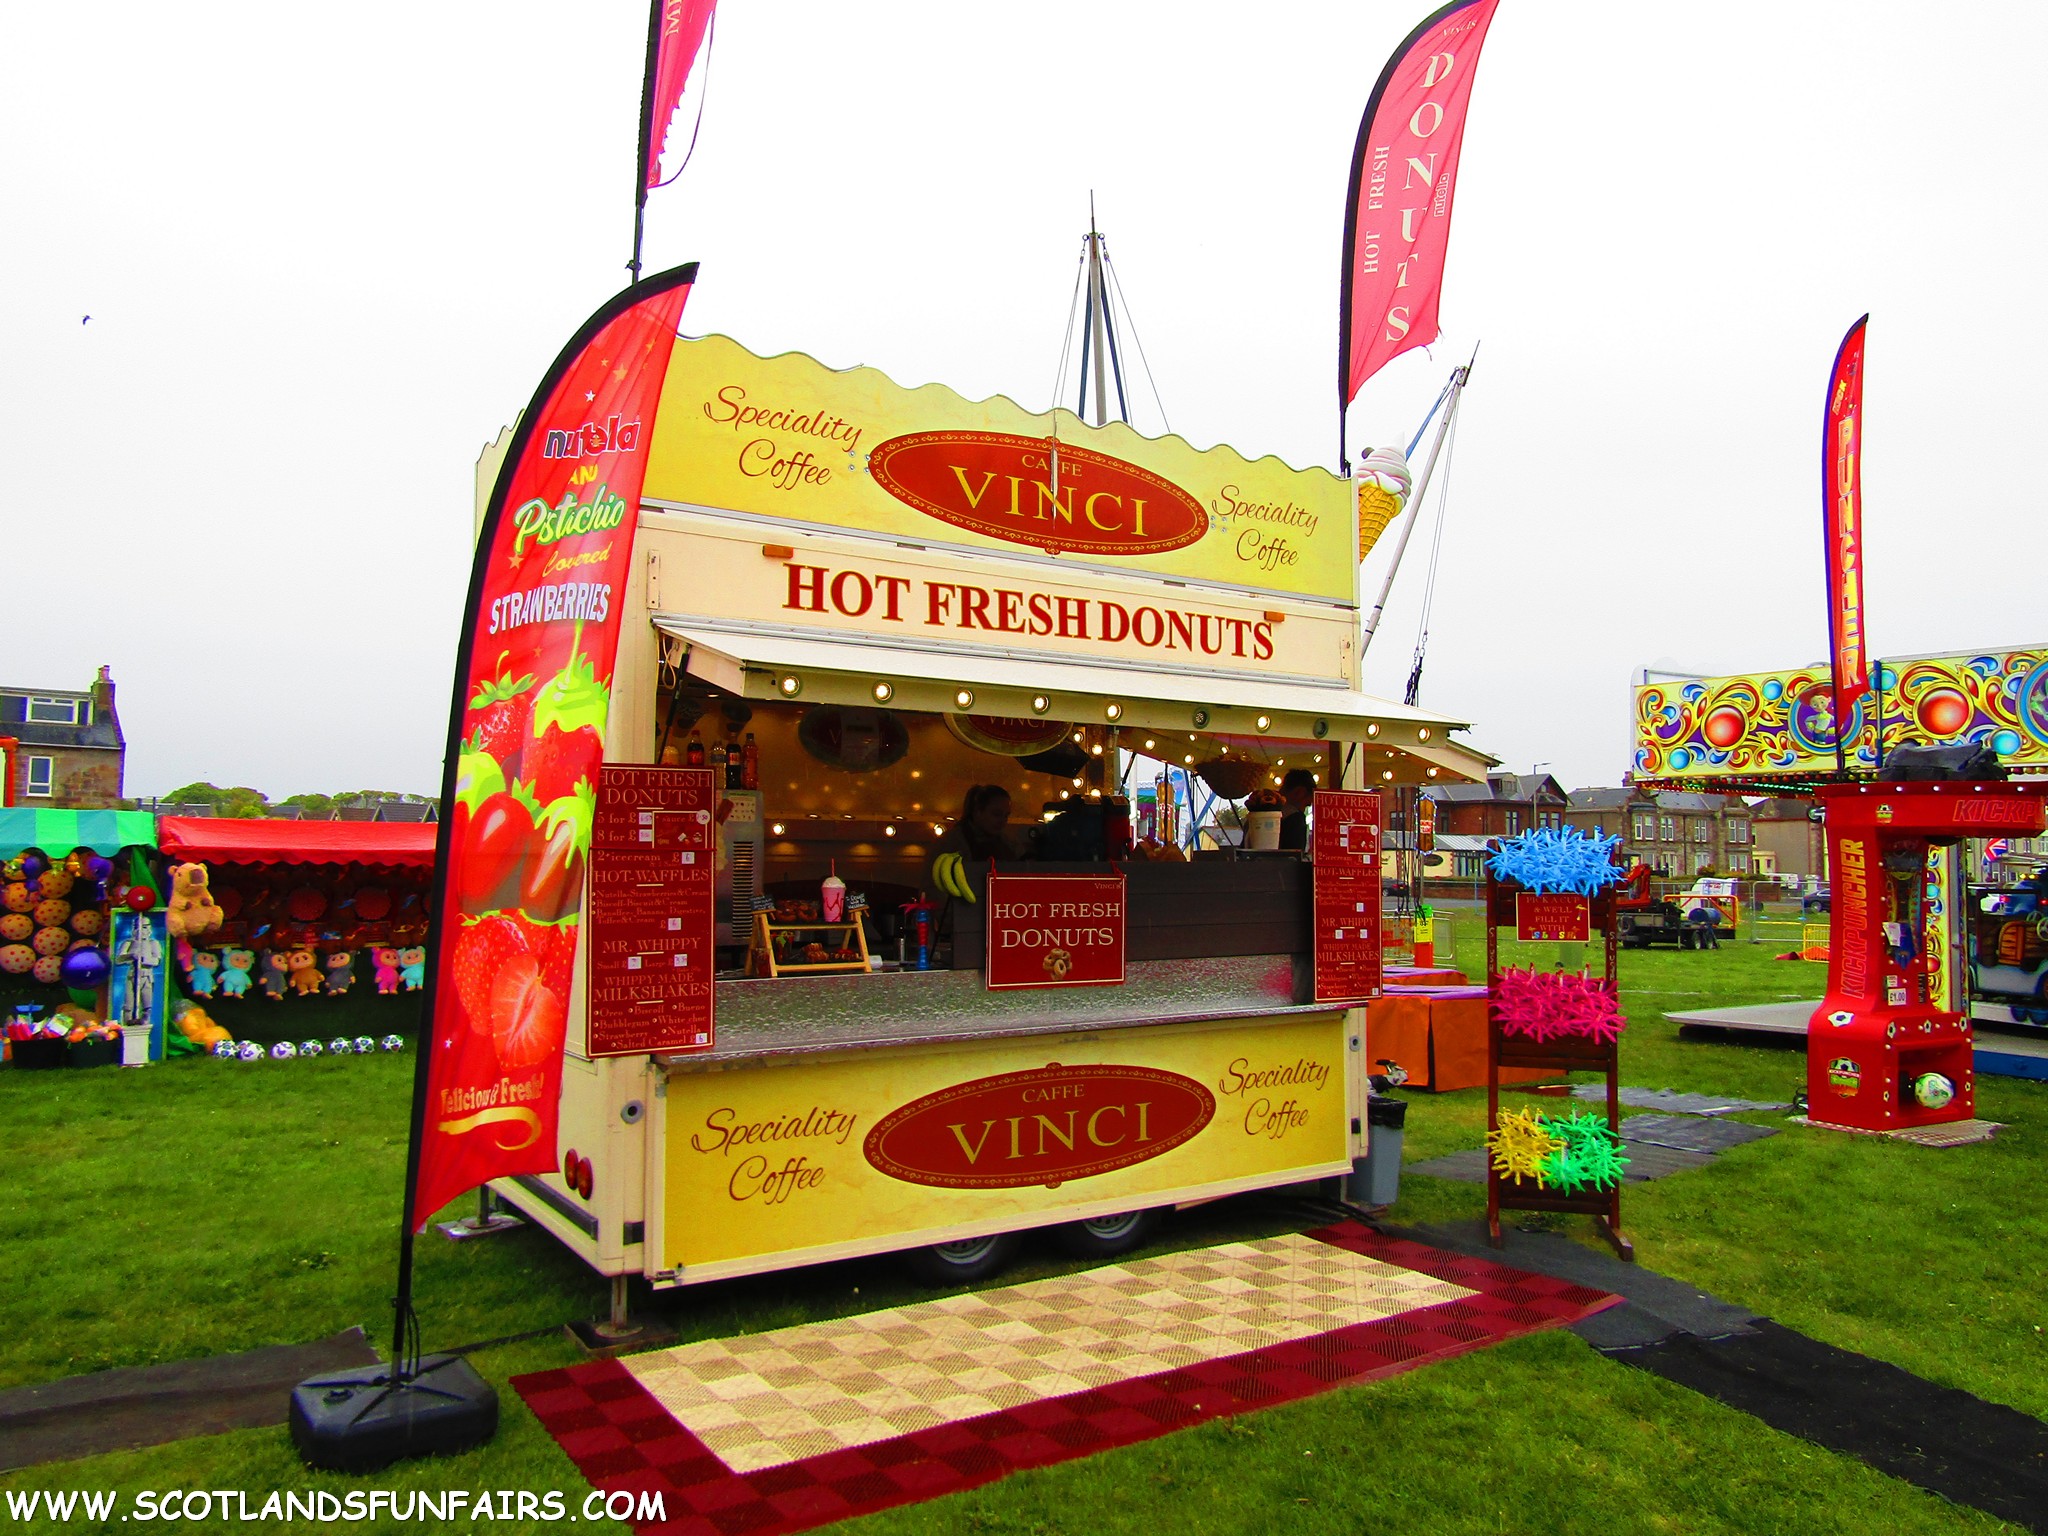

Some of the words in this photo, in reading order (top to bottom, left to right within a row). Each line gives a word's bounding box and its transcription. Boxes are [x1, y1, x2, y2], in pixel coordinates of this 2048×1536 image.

[1368, 145, 1390, 210] FRESH
[1386, 52, 1455, 343] DONUTS
[1433, 172, 1450, 218] nutella
[1363, 231, 1381, 274] HOT
[703, 386, 862, 453] Speciality
[739, 438, 832, 491] Coffee
[1021, 454, 1082, 477] CAFE
[948, 465, 1148, 537] VINCI
[1211, 484, 1319, 537] Speciality
[542, 541, 613, 578] Covered
[1236, 528, 1299, 571] Coffee
[1836, 415, 1862, 691] PUNCHER
[489, 582, 611, 634] STRAWBERRIES
[782, 562, 911, 622] HOT
[923, 580, 1091, 640] FRESH
[1097, 600, 1274, 661] DONUTS
[645, 771, 711, 788] FRESH
[605, 788, 698, 806] DONUTS
[1316, 795, 1341, 806] HOT
[1343, 796, 1378, 808] FRESH
[597, 811, 604, 823] 5
[609, 813, 625, 823] for
[628, 812, 637, 823] £
[1322, 808, 1372, 820] DONUTS
[597, 830, 604, 842] 8
[609, 831, 625, 841] for
[628, 830, 637, 842] £
[672, 851, 680, 862] £
[1526, 896, 1549, 904] PICK
[1560, 896, 1580, 904] CUP
[994, 903, 1042, 919] HOT
[1049, 902, 1121, 918] FRESH
[1840, 838, 1865, 999] KICKPUNCHER
[1340, 917, 1375, 927] WHIPPY
[1540, 924, 1566, 932] WITH
[602, 941, 633, 954] MR.
[637, 938, 702, 952] WHIPPY
[1001, 927, 1114, 948] DONUTS
[1317, 951, 1380, 962] MILKSHAKES
[604, 974, 656, 987] WHIPPY
[657, 972, 695, 984] MADE
[594, 982, 710, 1002] MILKSHAKES
[1889, 992, 1906, 1002] £1.00
[600, 1007, 623, 1017] Oreo
[634, 1005, 664, 1015] Biscoff
[678, 1002, 705, 1012] Bueno
[600, 1018, 650, 1029] Bubblegum
[658, 1015, 687, 1025] White
[688, 1013, 707, 1023] choc
[598, 1030, 648, 1041] Strawberry
[667, 1025, 701, 1036] Nutella
[616, 1038, 646, 1049] Salted
[648, 1035, 687, 1046] Caramel
[1219, 1057, 1330, 1098] Speciality
[1022, 1083, 1085, 1103] CAFFE
[1244, 1097, 1310, 1140] Coffee
[691, 1107, 857, 1157] Speciality
[947, 1102, 1153, 1165] VINCI
[729, 1155, 826, 1205] Coffee
